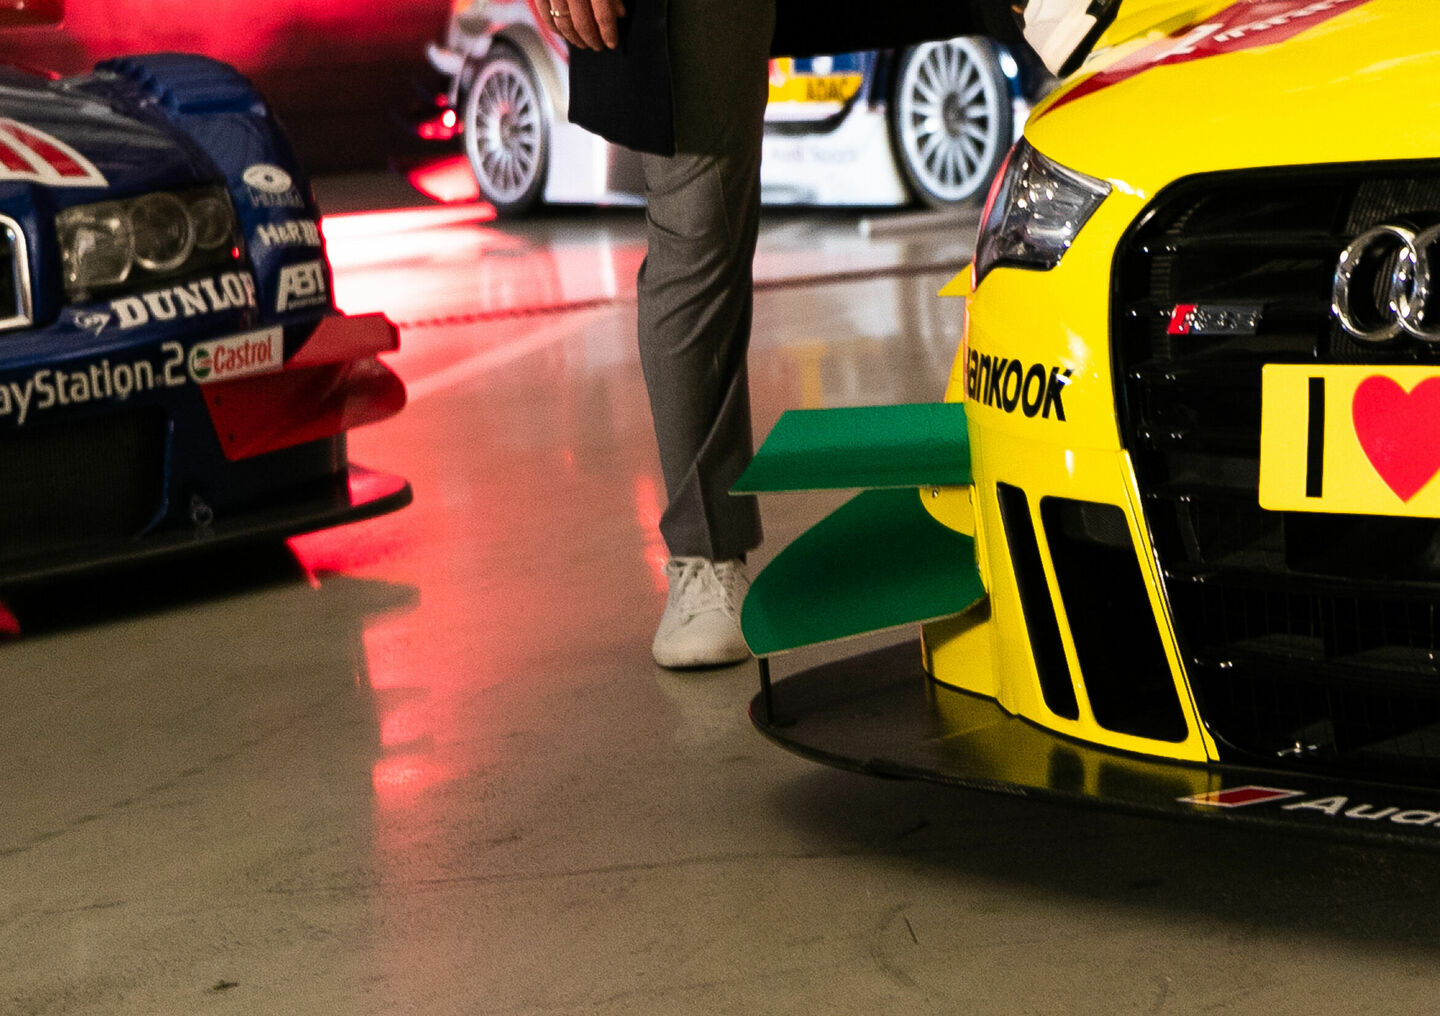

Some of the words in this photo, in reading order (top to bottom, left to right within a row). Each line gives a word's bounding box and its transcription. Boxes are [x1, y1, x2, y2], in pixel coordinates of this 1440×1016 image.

[276, 261, 327, 313] ABT
[213, 334, 272, 374] Castrol
[1305, 376, 1326, 499] I
